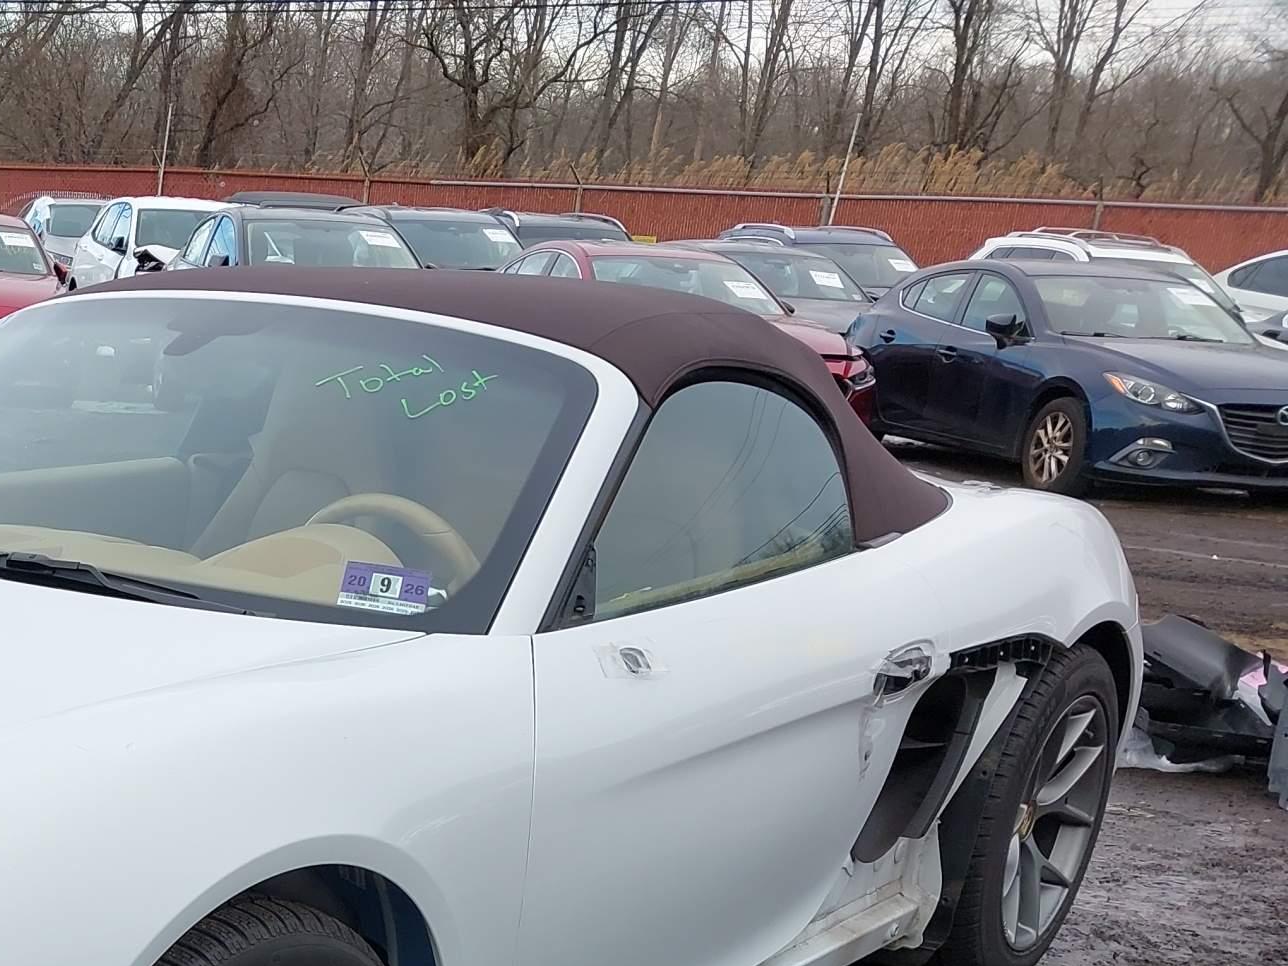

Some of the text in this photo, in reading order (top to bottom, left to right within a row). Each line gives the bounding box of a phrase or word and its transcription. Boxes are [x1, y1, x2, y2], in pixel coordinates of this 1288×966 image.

[315, 354, 445, 399] Total
[400, 369, 500, 419] Lost
[348, 575, 425, 596] 20 9 26
